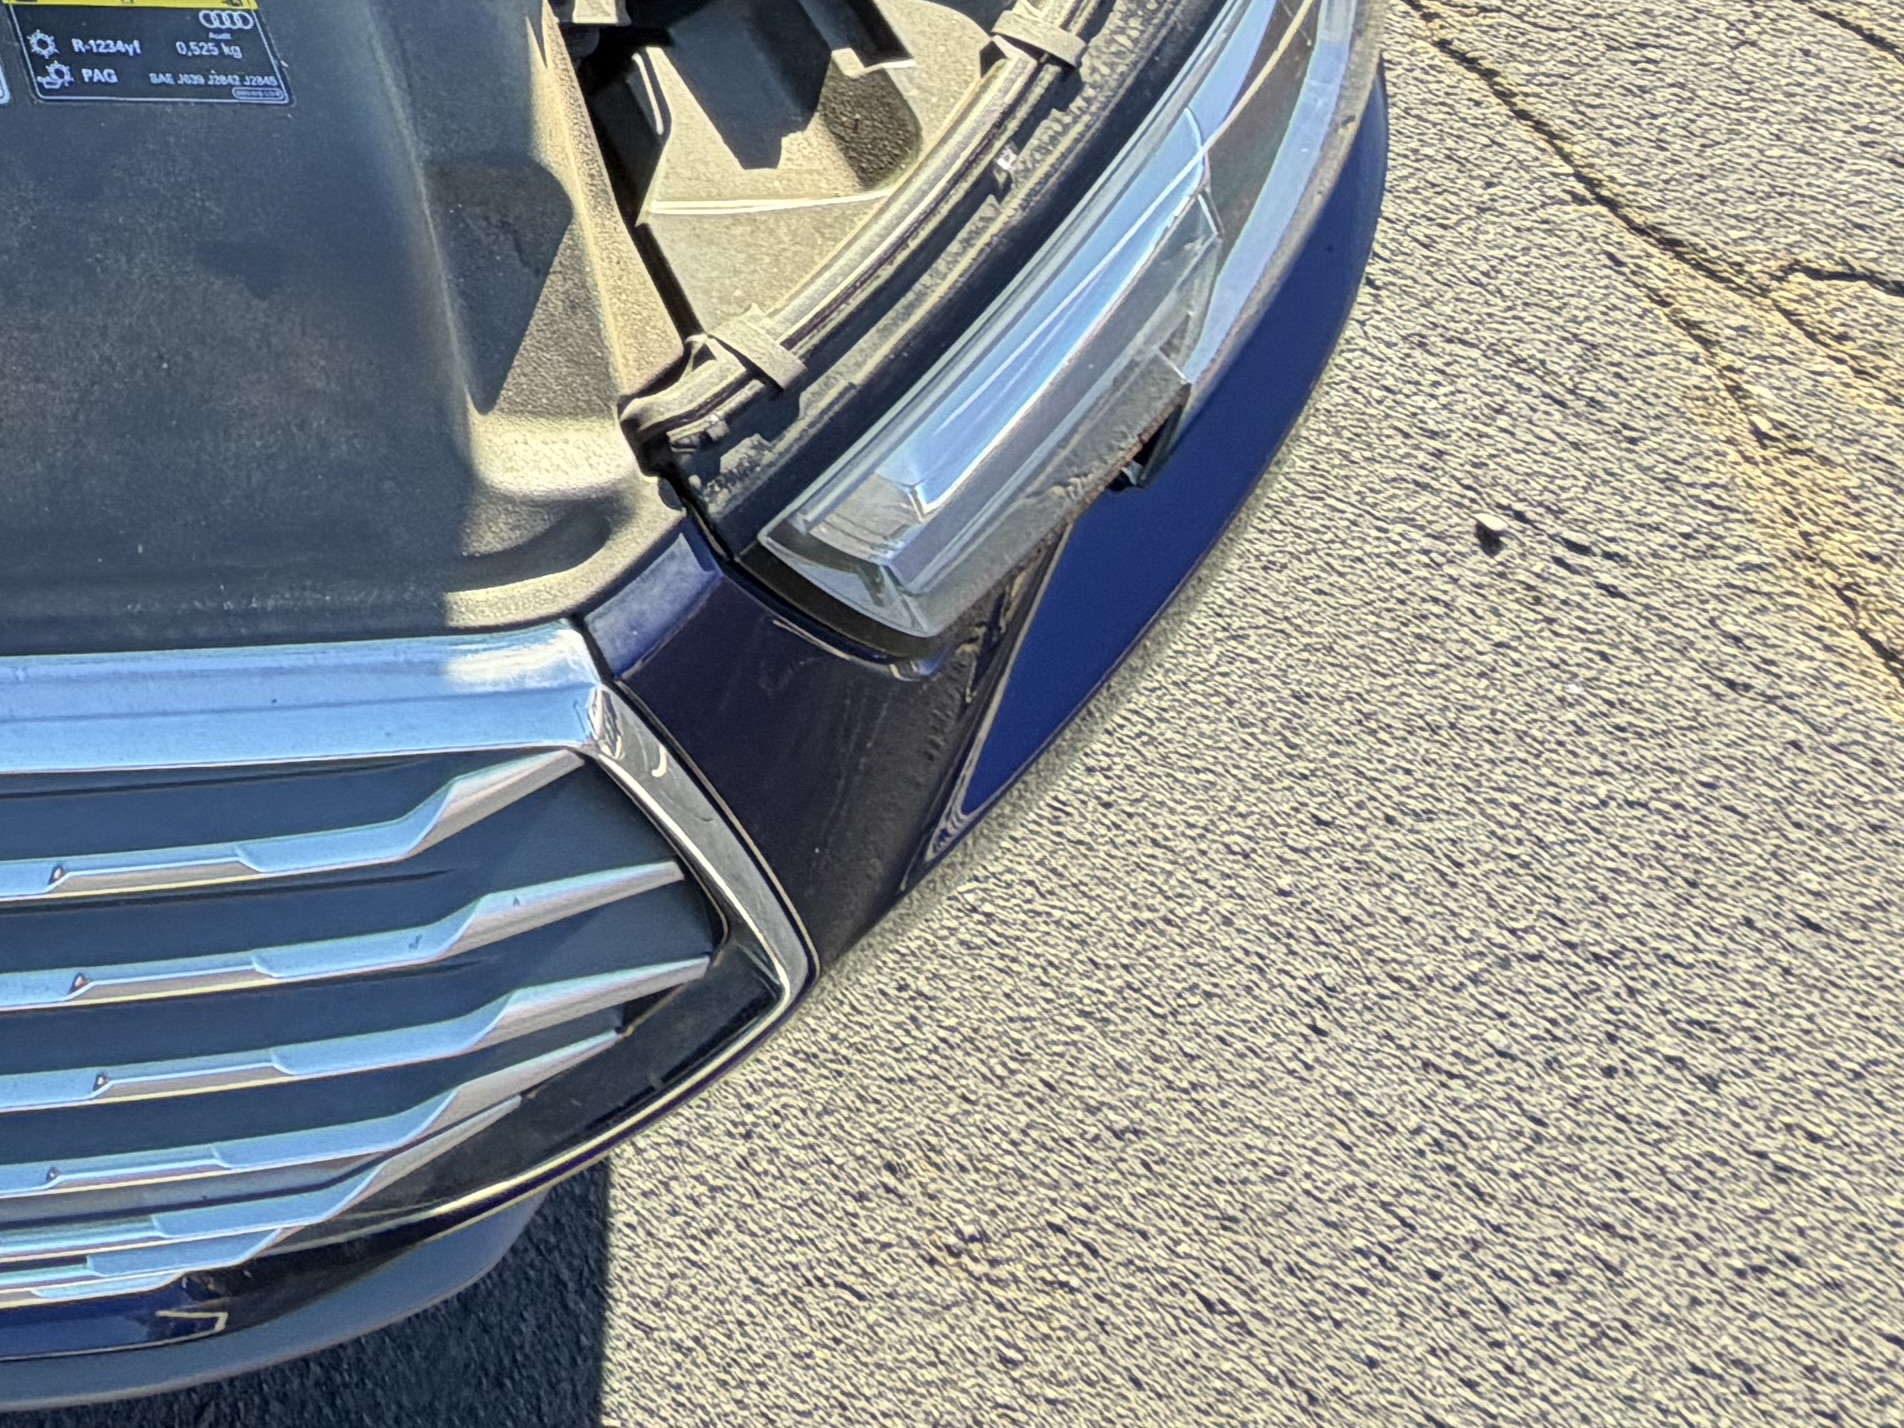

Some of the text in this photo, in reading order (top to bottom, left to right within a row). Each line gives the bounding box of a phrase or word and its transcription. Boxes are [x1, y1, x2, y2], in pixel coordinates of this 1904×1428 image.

[72, 39, 243, 59] R-1234yf 0,525 kg
[82, 68, 118, 83] PAG
